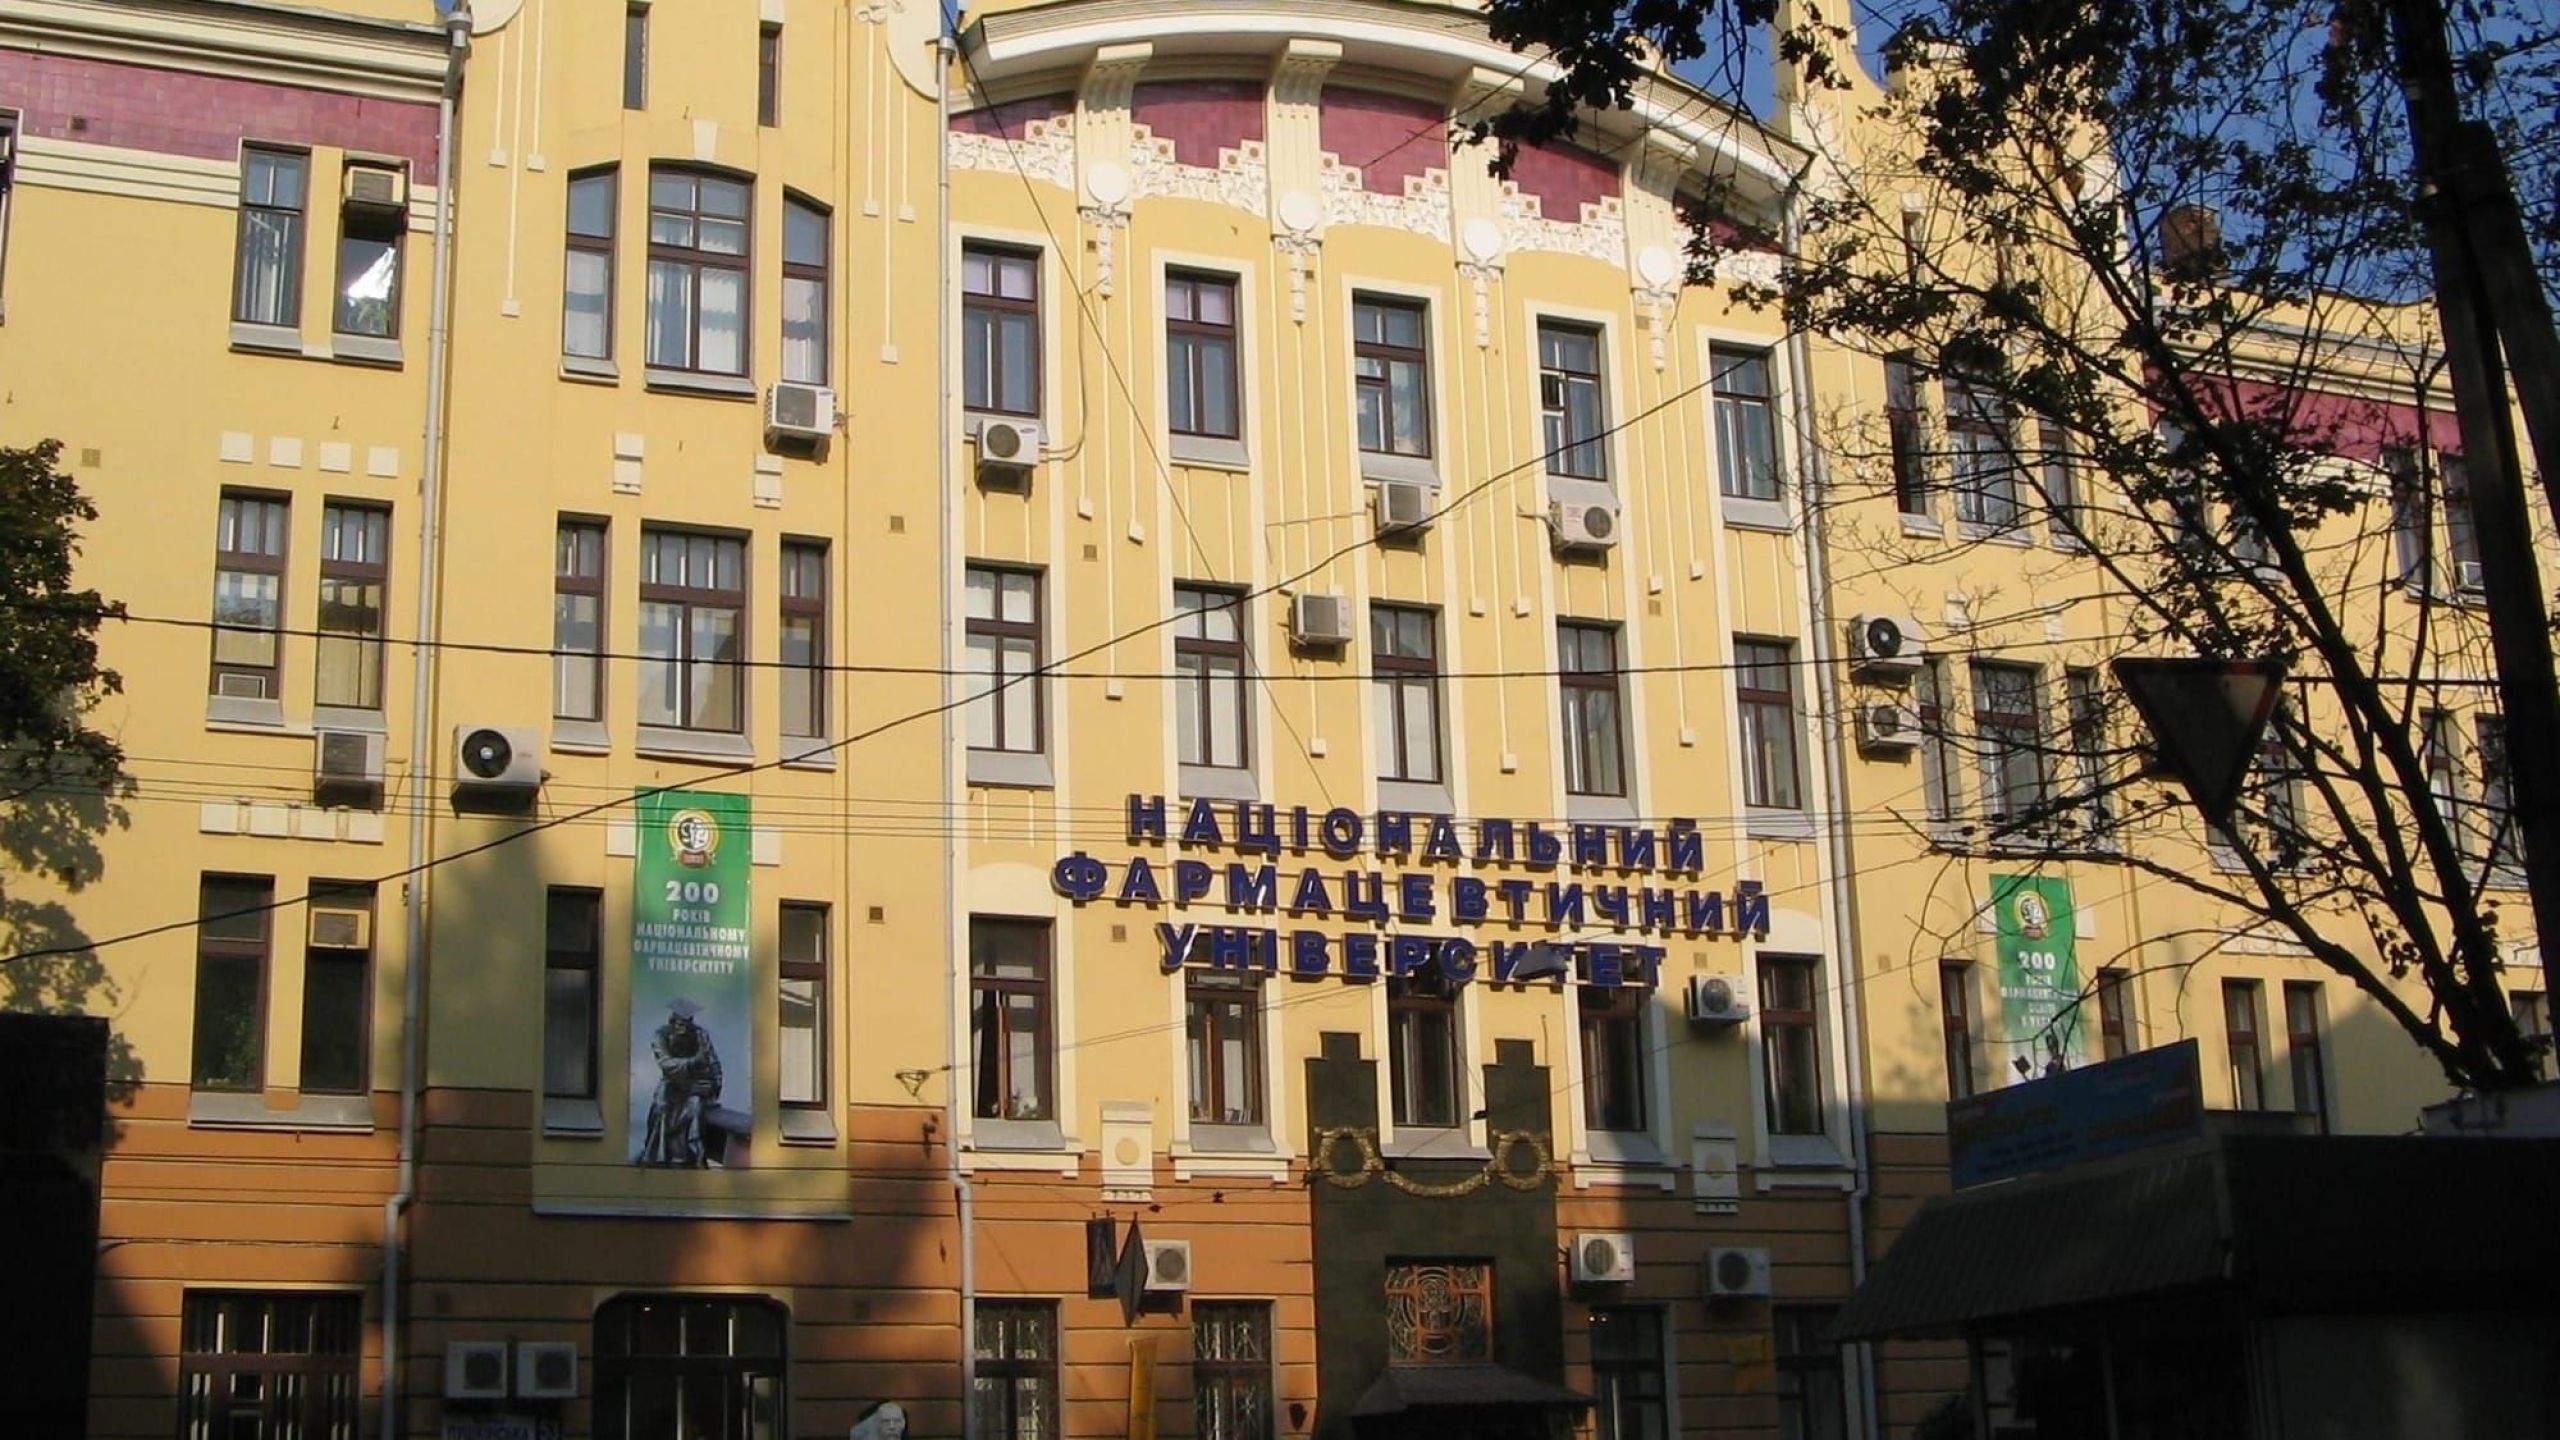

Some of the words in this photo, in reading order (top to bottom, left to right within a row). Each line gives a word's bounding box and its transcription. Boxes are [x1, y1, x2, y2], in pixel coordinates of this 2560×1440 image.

[1127, 795, 1703, 874] НАЦІОНАЛЬНИЙ
[666, 881, 719, 903] 200
[1052, 851, 1769, 942] ФАРМАЦЕВТИЧНИЙ
[2018, 951, 2056, 970] 200
